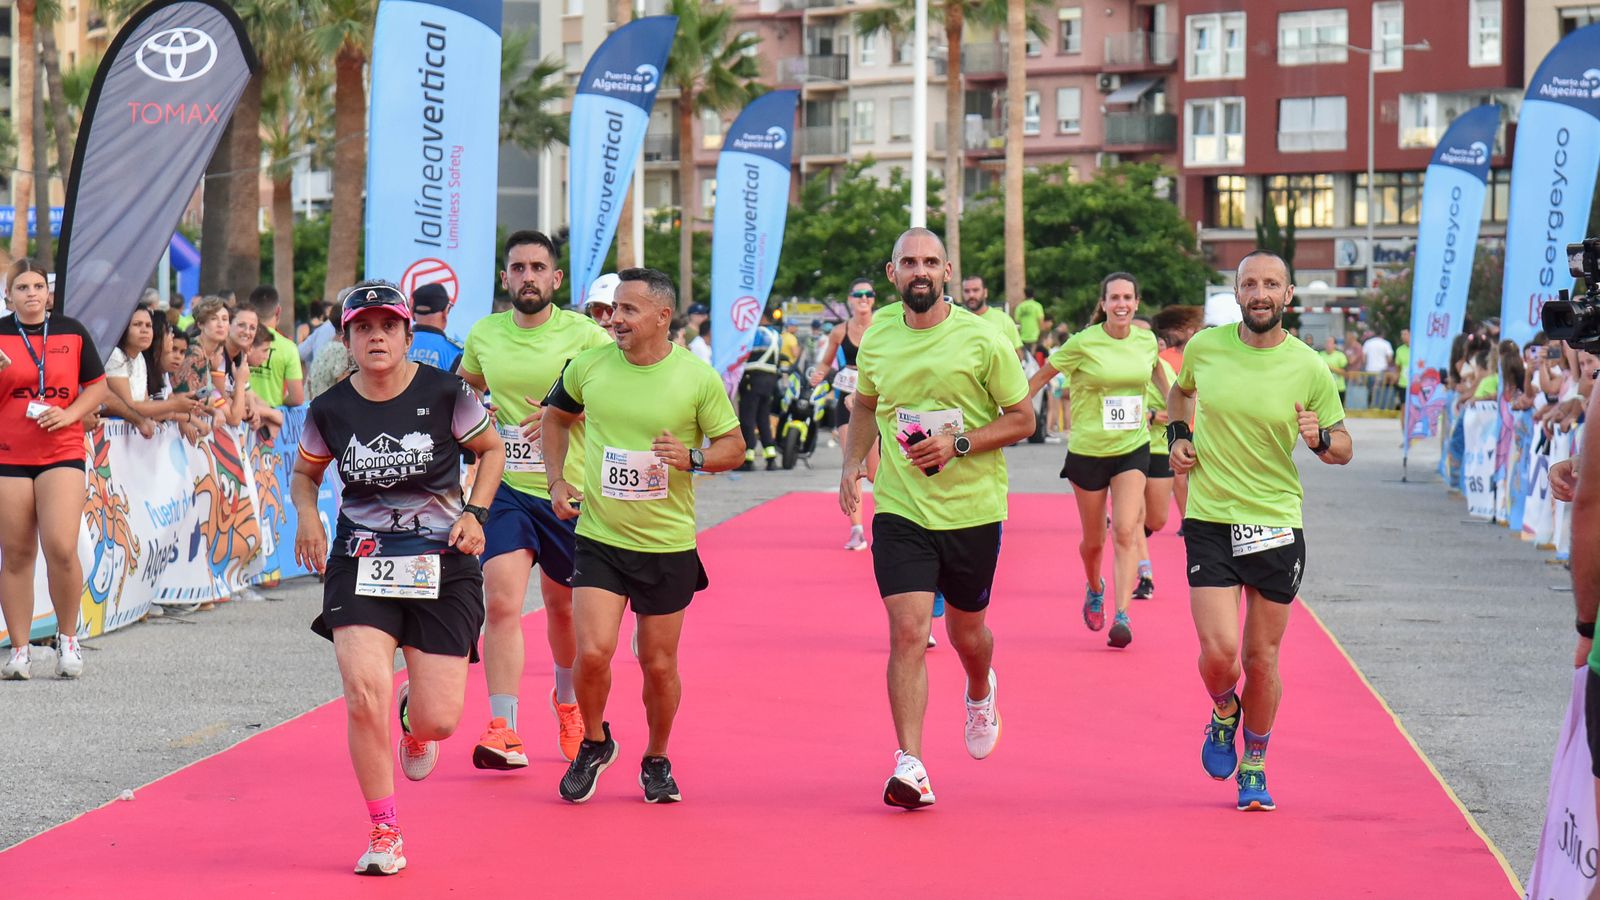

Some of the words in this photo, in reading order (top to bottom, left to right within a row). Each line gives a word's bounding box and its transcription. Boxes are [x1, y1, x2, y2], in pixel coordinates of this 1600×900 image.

[605, 70, 632, 82] Puerto
[633, 74, 643, 82] de
[1552, 76, 1577, 87] Puerto
[1579, 78, 1590, 87] de
[592, 79, 643, 92] Algeciras
[1539, 82, 1589, 98] Algeciras
[127, 102, 221, 125] TOMAX
[414, 20, 447, 248] lalíneavertical
[448, 145, 465, 188] Safety
[1539, 127, 1571, 288] Sergeyco
[447, 193, 460, 249] Limitless
[1434, 185, 1463, 309] Sergeyco
[10, 386, 70, 399] EVOS
[1110, 408, 1125, 421] 90
[504, 441, 531, 459] 852
[350, 466, 424, 481] TRAIL
[609, 466, 640, 487] 853
[1232, 523, 1264, 541] 854
[370, 559, 396, 581] 32
